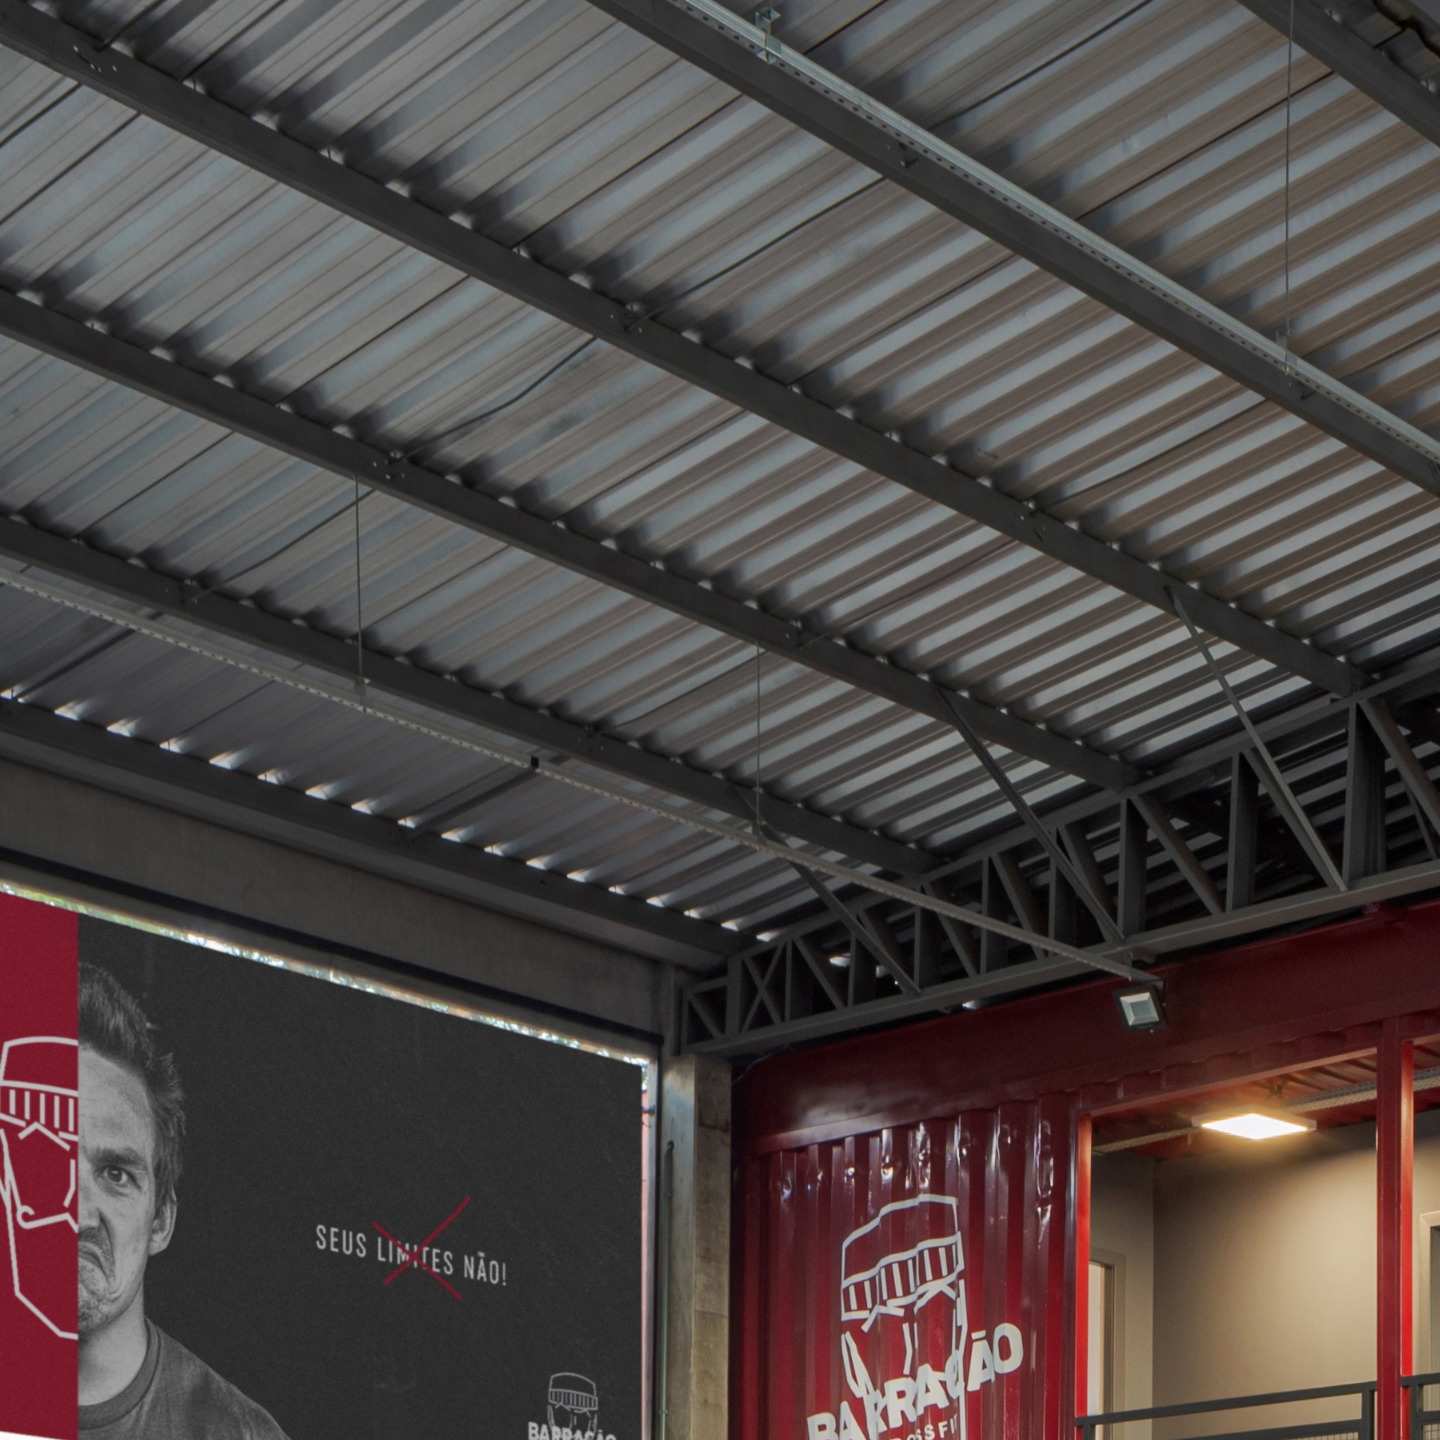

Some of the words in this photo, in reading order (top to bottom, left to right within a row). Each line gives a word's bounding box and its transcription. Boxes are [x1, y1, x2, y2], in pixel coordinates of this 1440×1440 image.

[316, 1224, 367, 1258] SEUS
[377, 1237, 454, 1275] LIMITES
[464, 1251, 507, 1286] NÃO!
